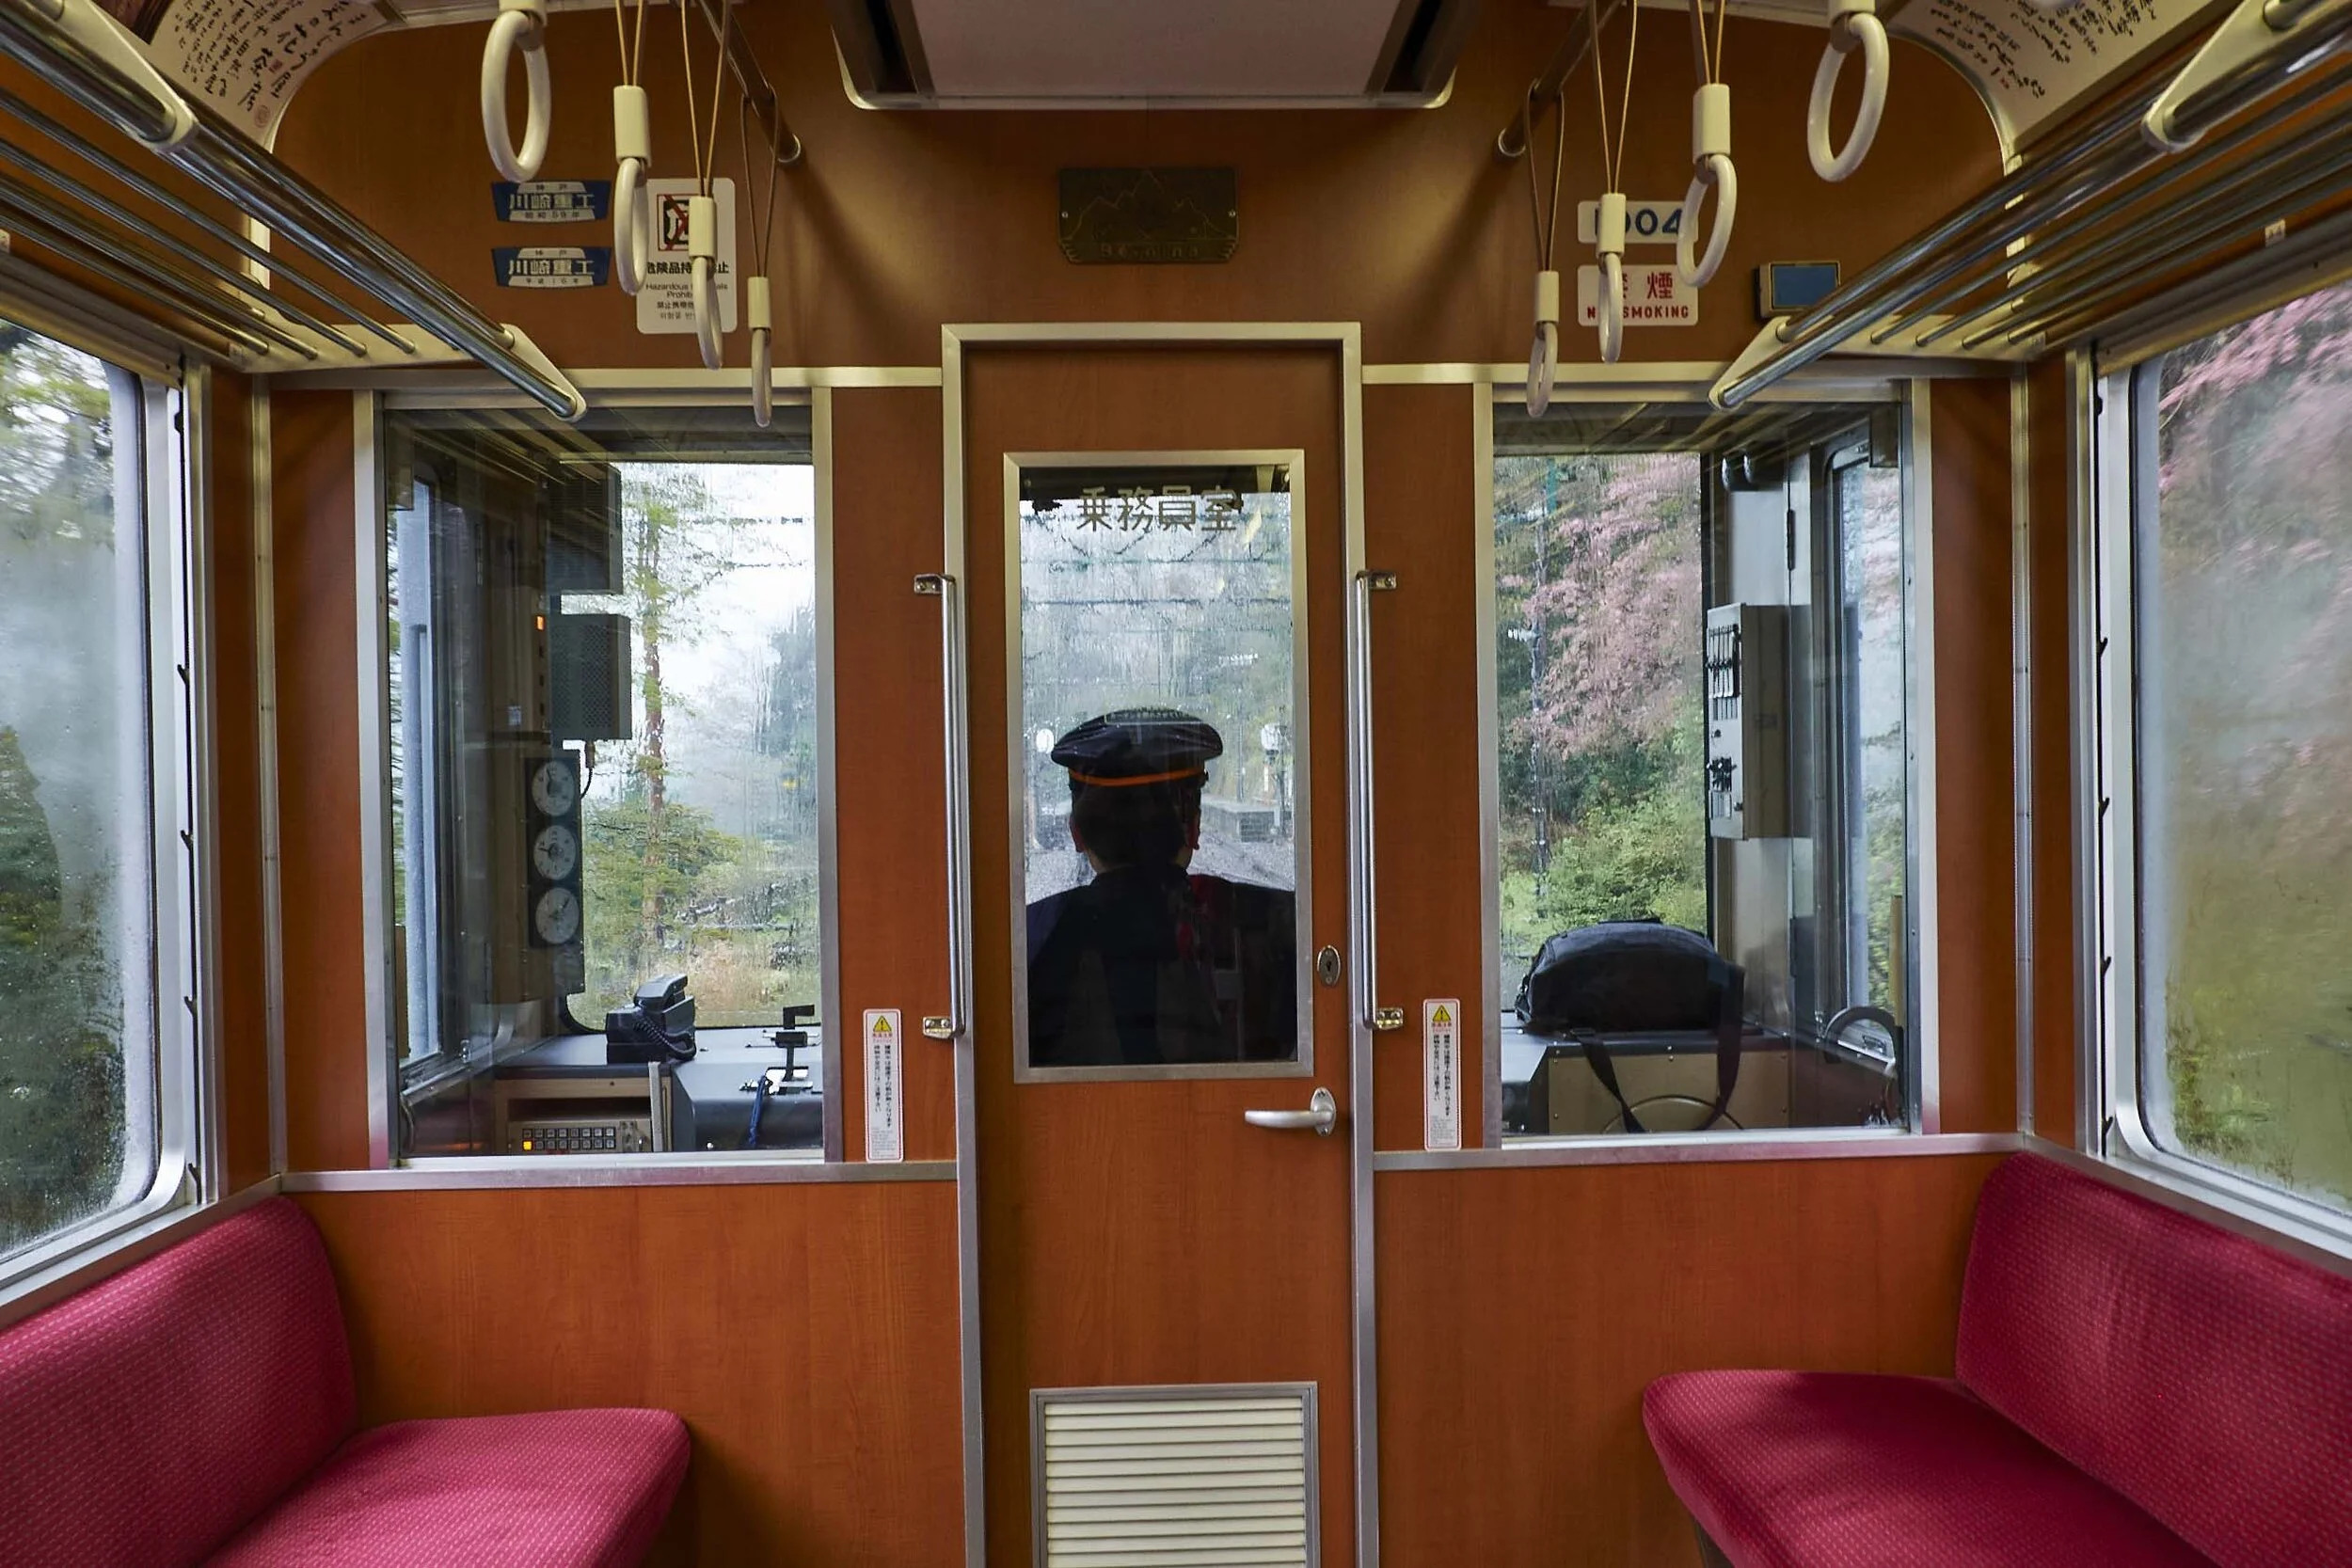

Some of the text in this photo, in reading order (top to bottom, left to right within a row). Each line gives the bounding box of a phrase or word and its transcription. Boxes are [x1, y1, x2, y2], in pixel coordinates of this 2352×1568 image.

[1623, 306, 1689, 319] SMOKING
[1076, 484, 1237, 532] 乗務員室
